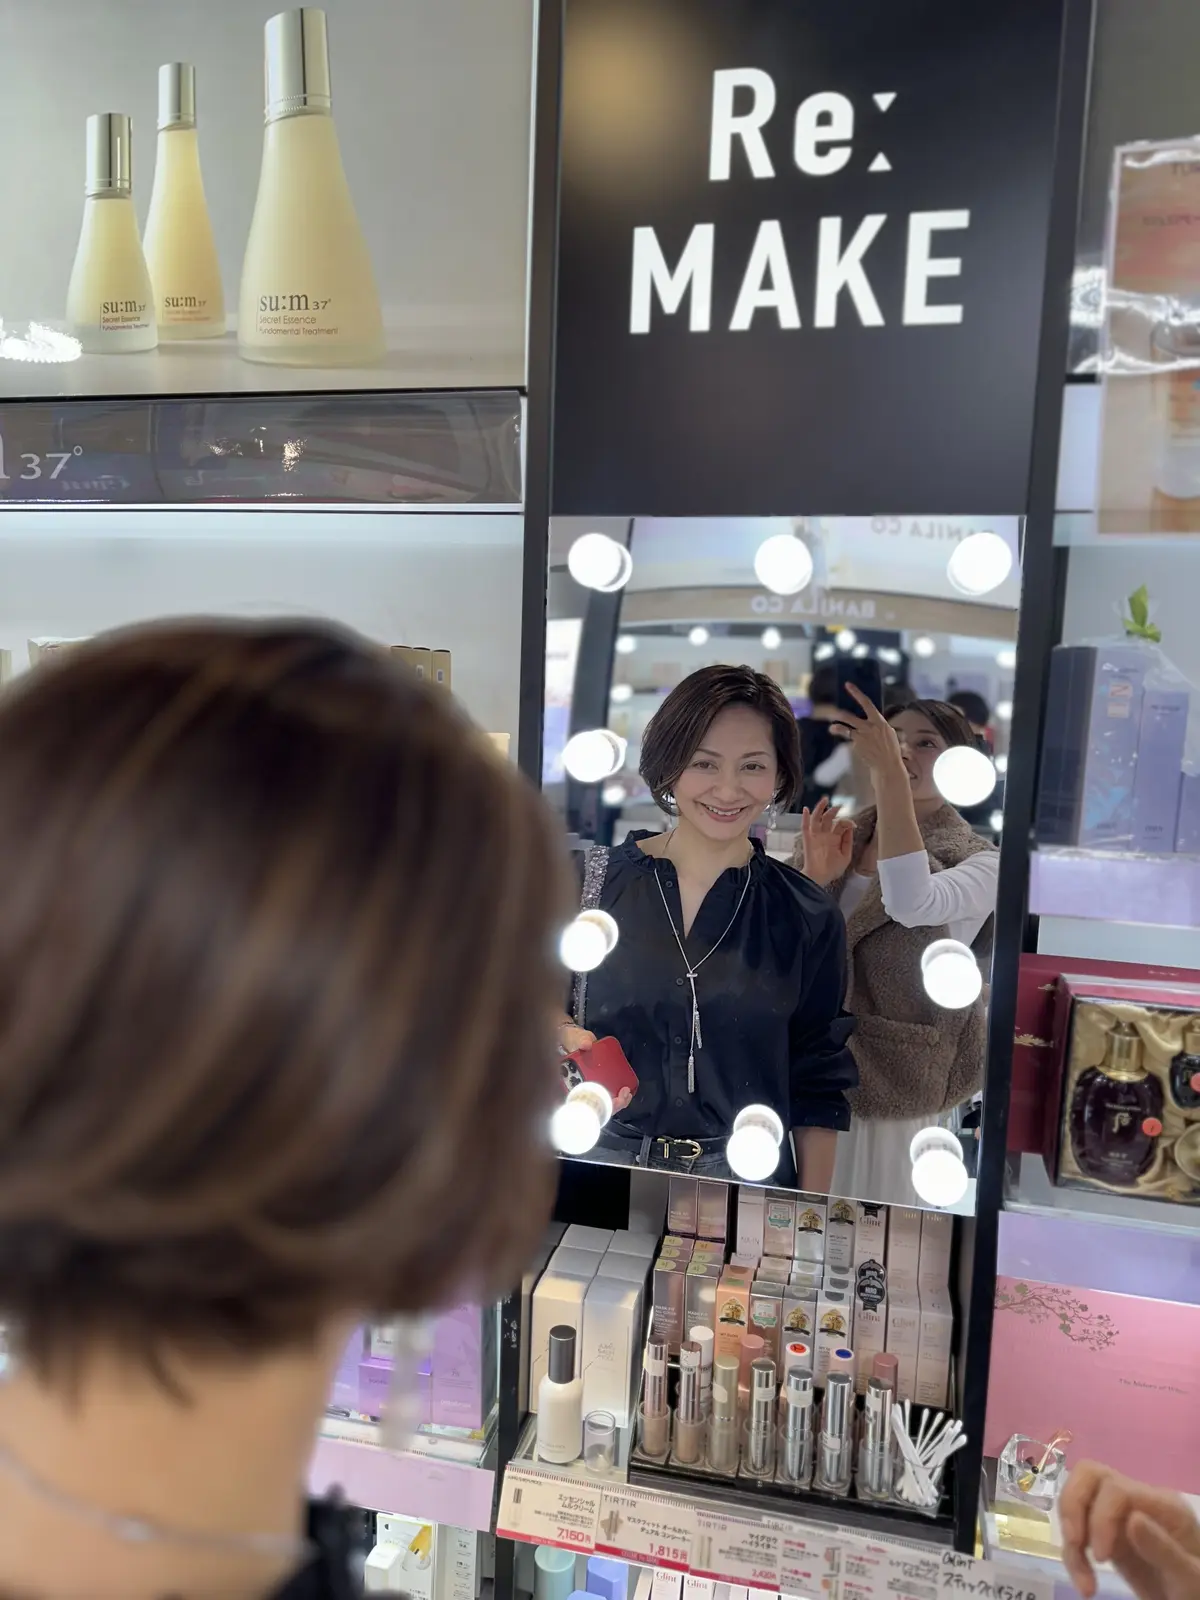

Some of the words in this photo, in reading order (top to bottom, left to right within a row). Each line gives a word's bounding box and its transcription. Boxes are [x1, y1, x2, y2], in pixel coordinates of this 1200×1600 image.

[628, 208, 971, 335] MAKE
[102, 299, 137, 314] su:m
[164, 295, 196, 308] su:m
[259, 293, 310, 312] su:m
[102, 316, 120, 324] Secret
[121, 315, 141, 323] Essence
[259, 315, 281, 324] Secret
[283, 315, 317, 325] Essence
[302, 327, 339, 336] Treatment
[557, 1493, 596, 1507] エッセンシャル
[603, 1494, 637, 1509] TIRTIR
[561, 1501, 595, 1514] ムルクリーム
[697, 1520, 727, 1532] TIRTIR
[748, 1533, 778, 1544] マイグロウ
